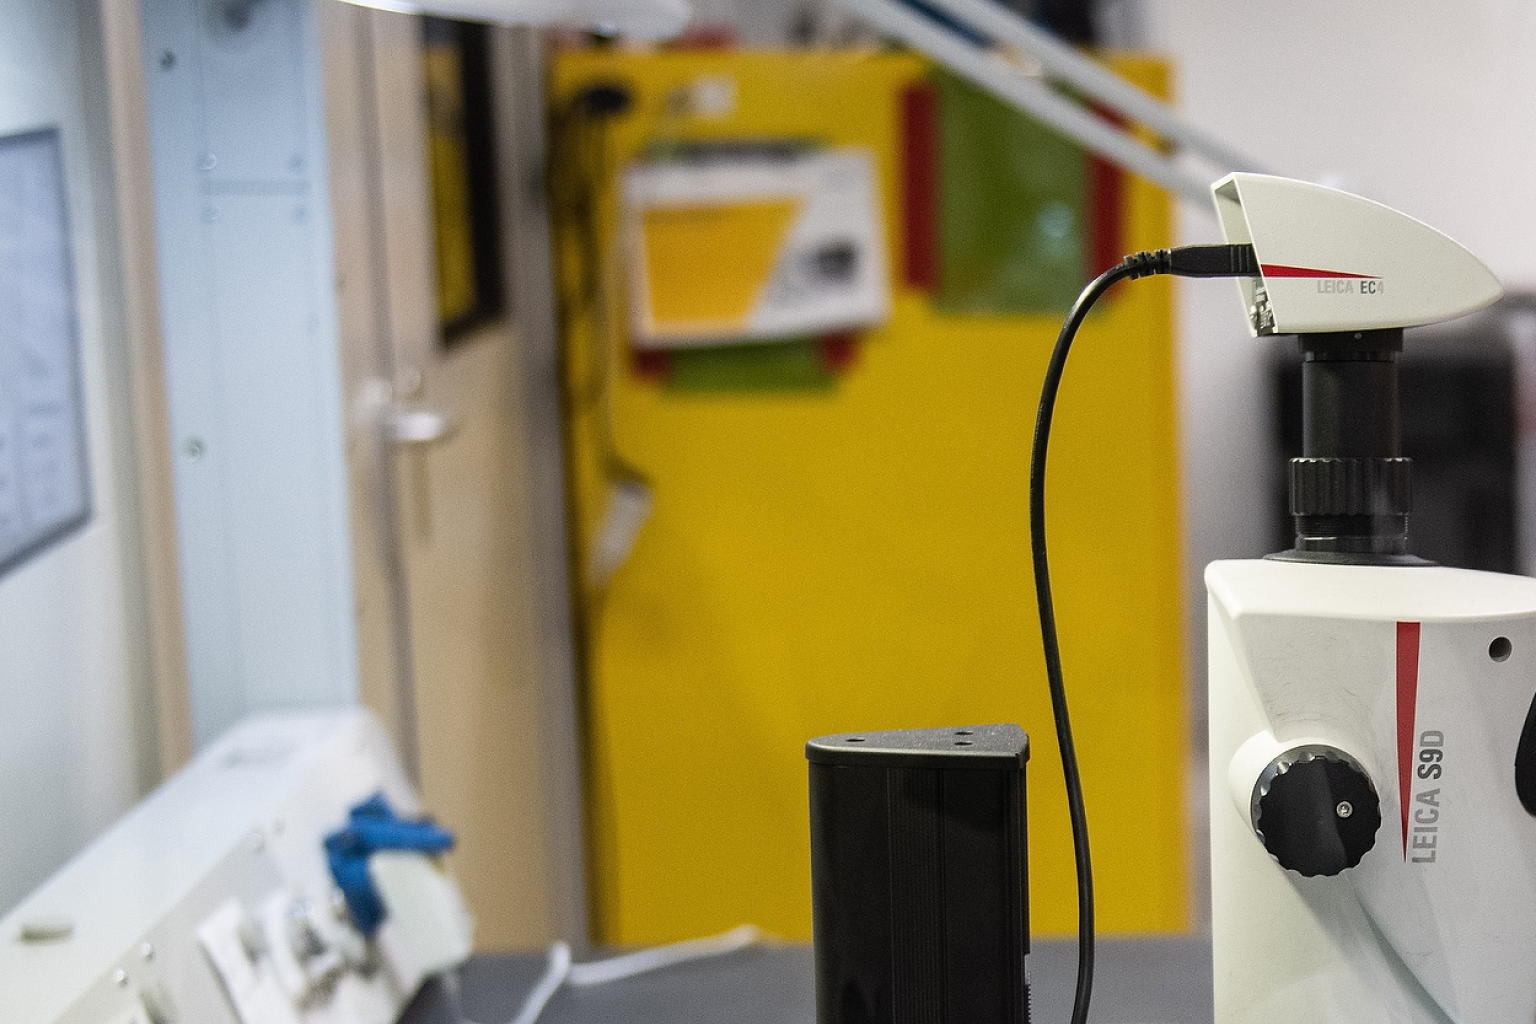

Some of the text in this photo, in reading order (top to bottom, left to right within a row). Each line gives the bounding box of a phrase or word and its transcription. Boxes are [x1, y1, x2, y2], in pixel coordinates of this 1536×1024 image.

[1317, 279, 1384, 294] LEICA EC4
[1411, 730, 1445, 863] LEICA S9D
